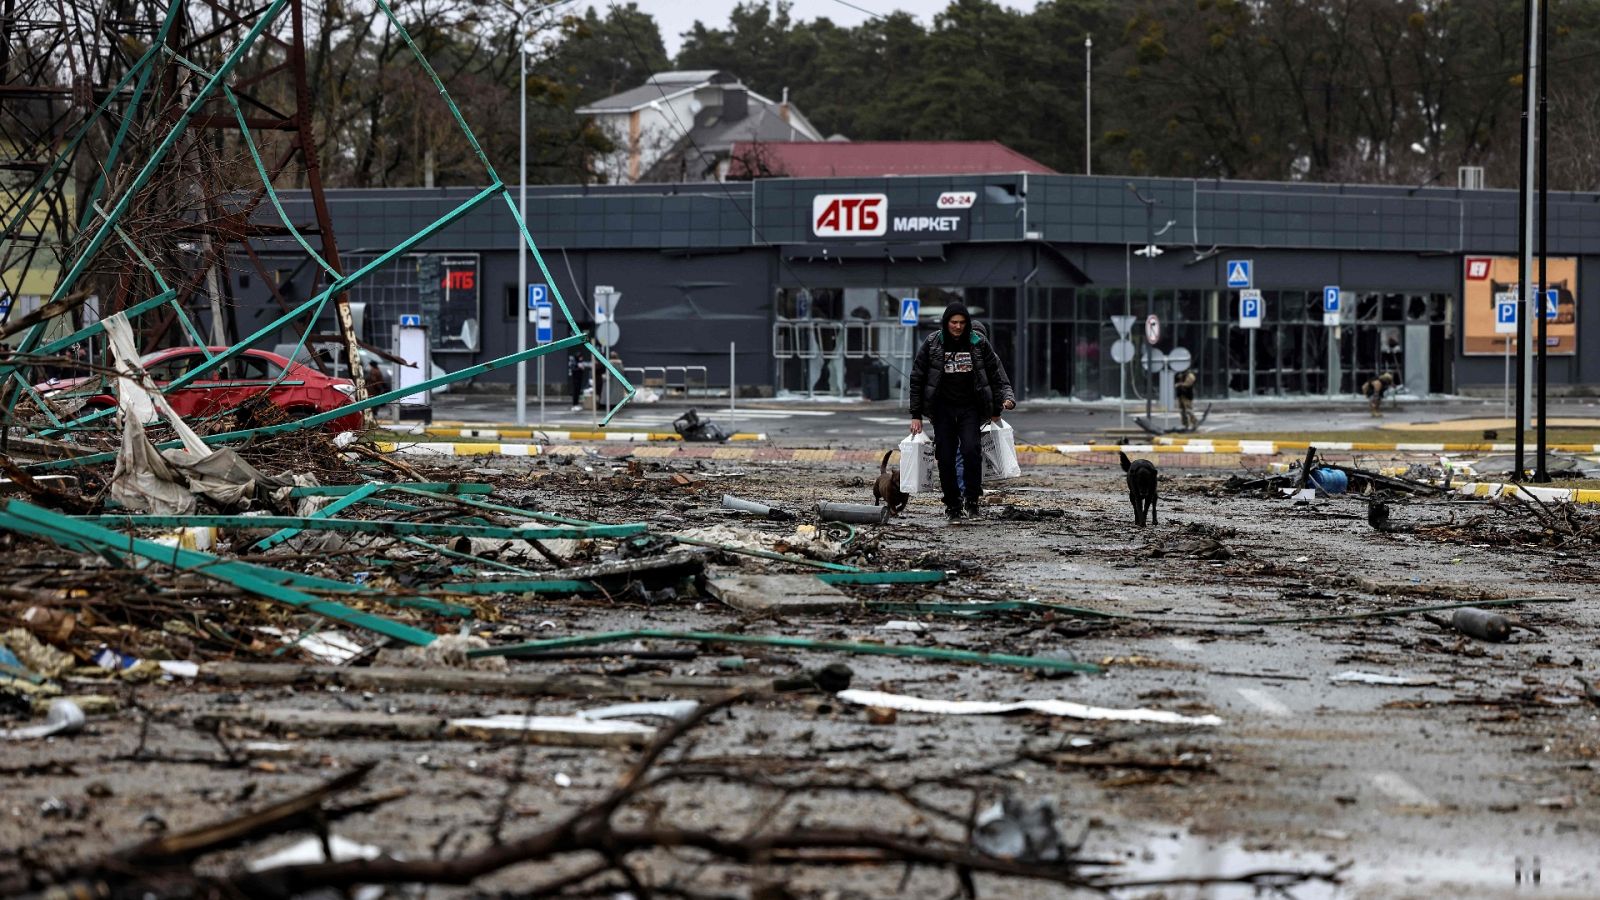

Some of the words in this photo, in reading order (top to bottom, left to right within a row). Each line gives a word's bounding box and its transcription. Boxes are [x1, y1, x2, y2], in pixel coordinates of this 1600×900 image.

[940, 196, 971, 205] 00-24
[816, 199, 882, 231] АТБ
[893, 216, 960, 232] МАРКЕТ
[441, 271, 475, 289] АТБ
[532, 287, 544, 306] P
[1327, 289, 1337, 309] P
[1246, 300, 1256, 316] P
[1502, 304, 1513, 322] P
